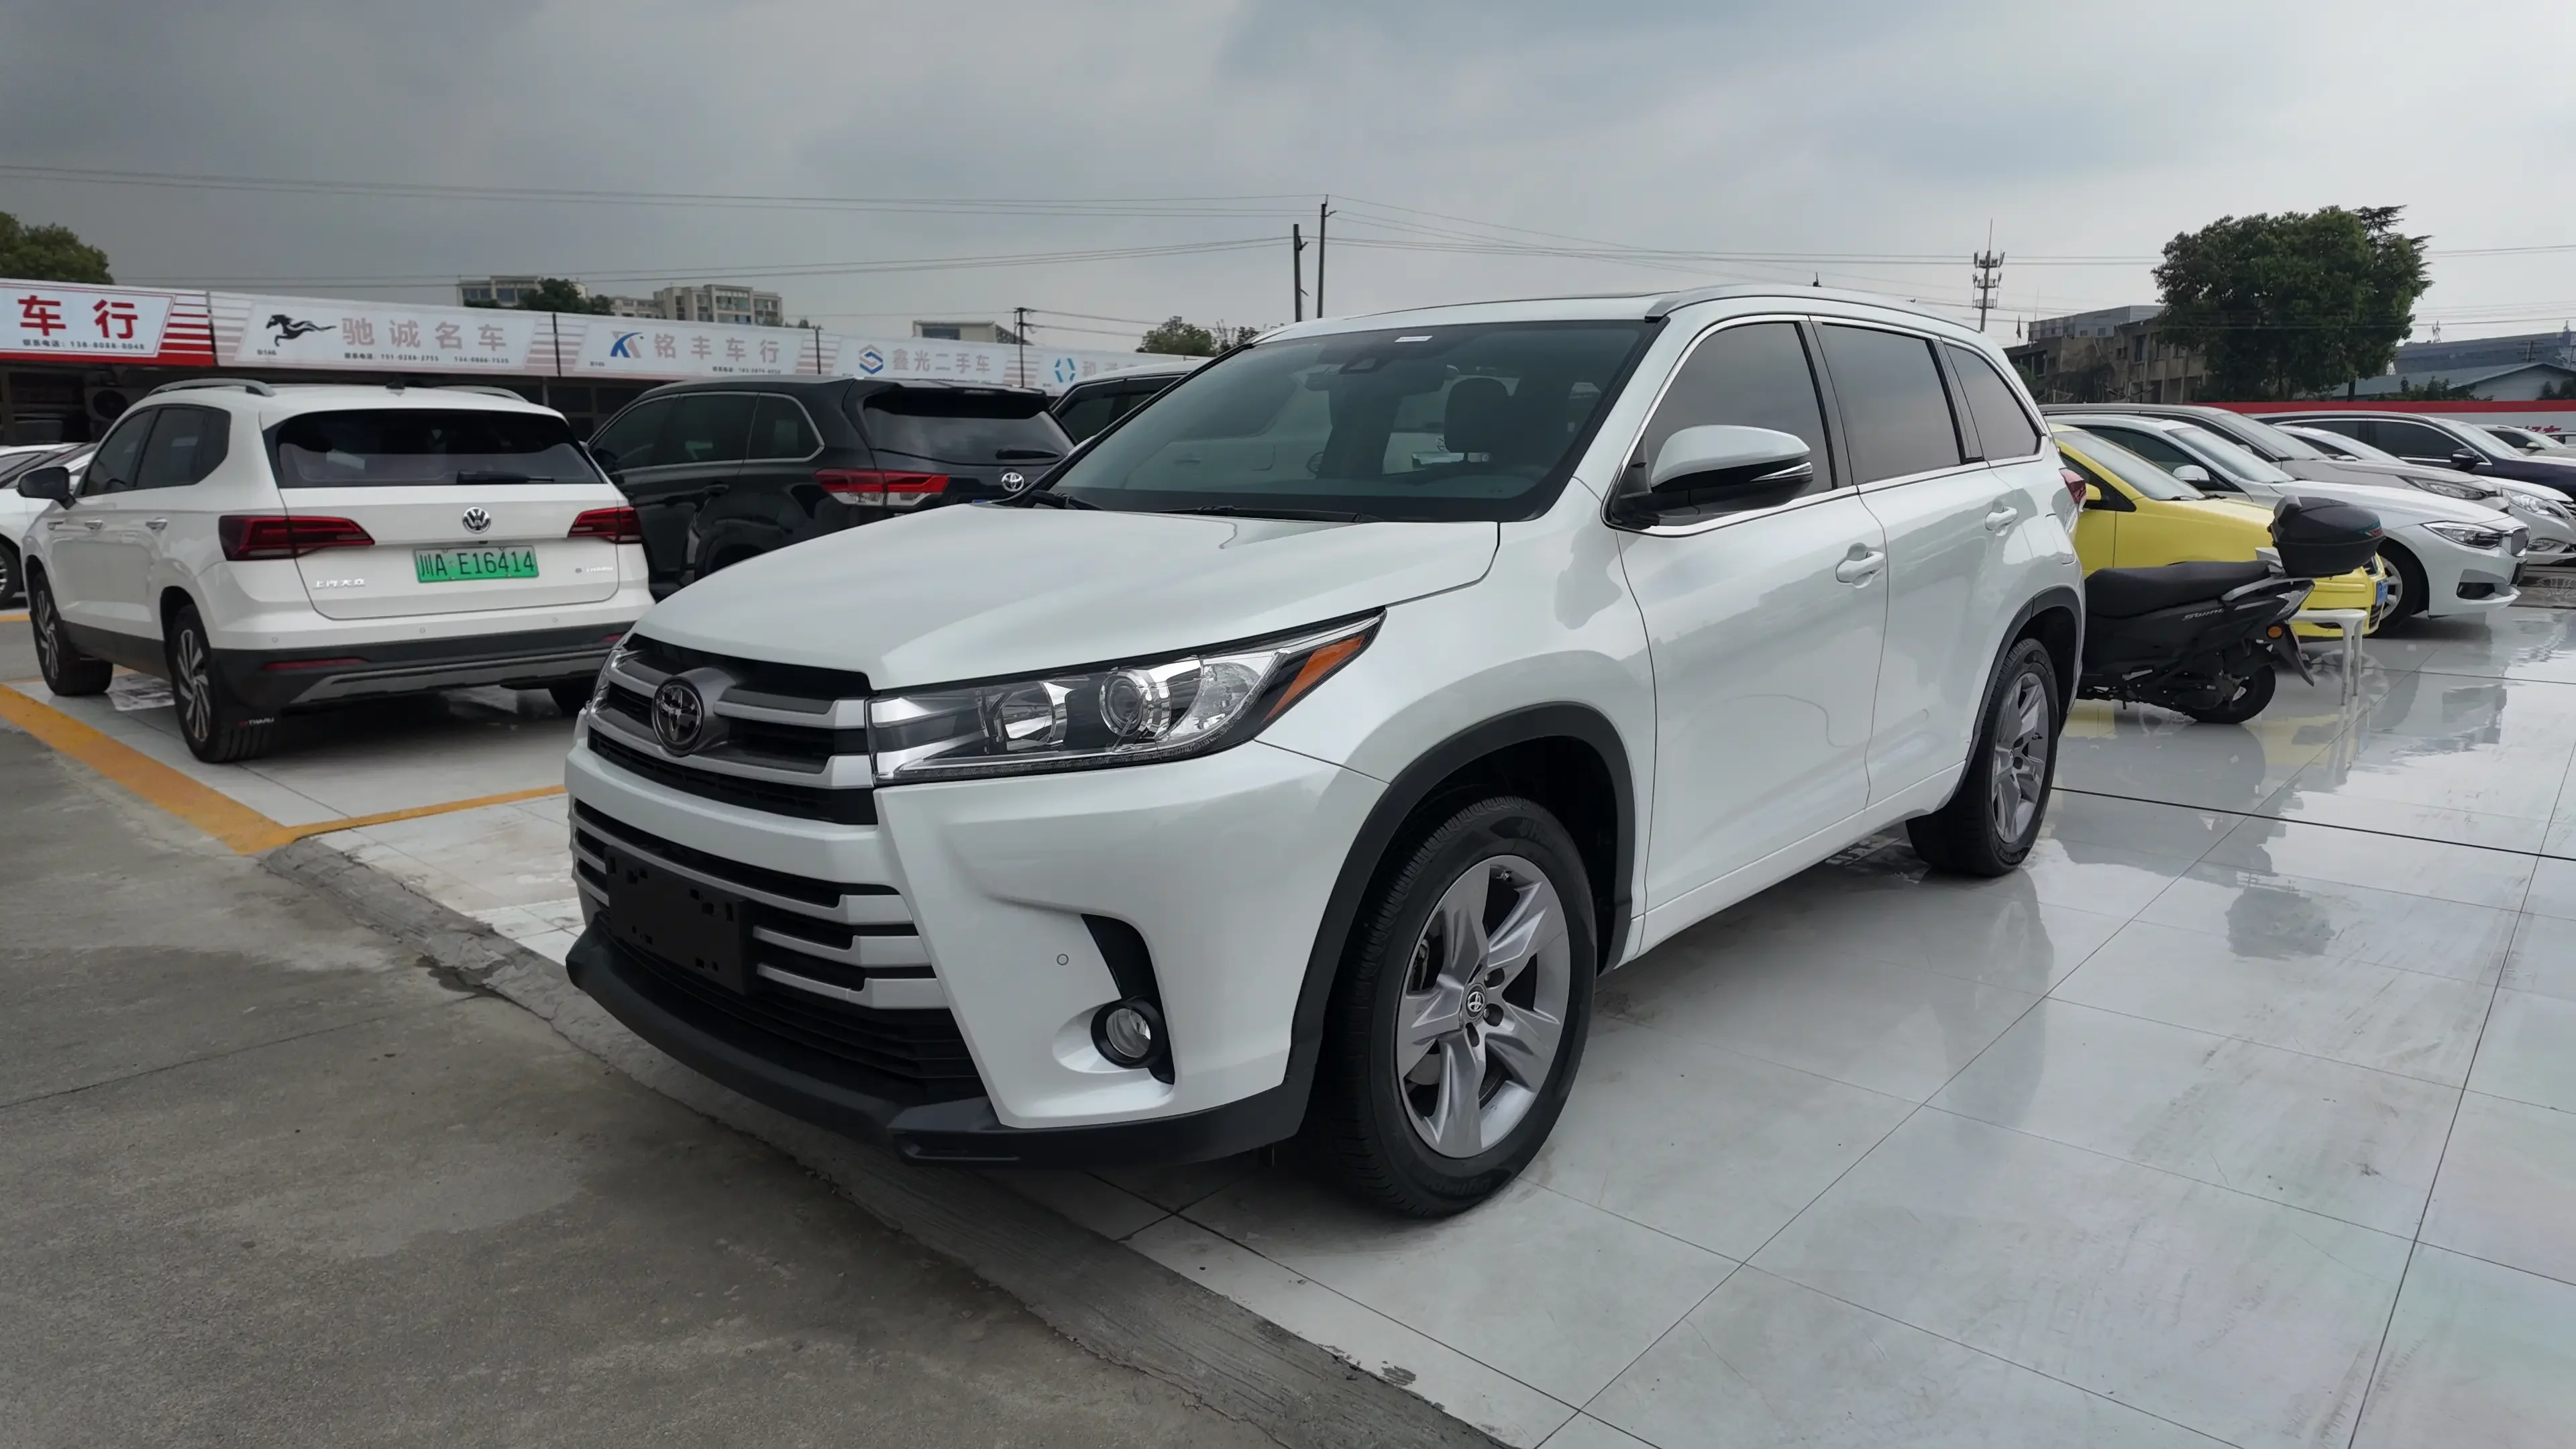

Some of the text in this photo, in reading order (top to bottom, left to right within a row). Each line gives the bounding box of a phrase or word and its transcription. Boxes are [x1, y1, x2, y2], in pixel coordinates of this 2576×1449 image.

[17, 295, 138, 339] 车行
[341, 317, 507, 352] 驰诚名车
[654, 332, 780, 364] 铭丰车行
[892, 348, 991, 374] 鑫光二手车
[458, 549, 535, 575] E16414
